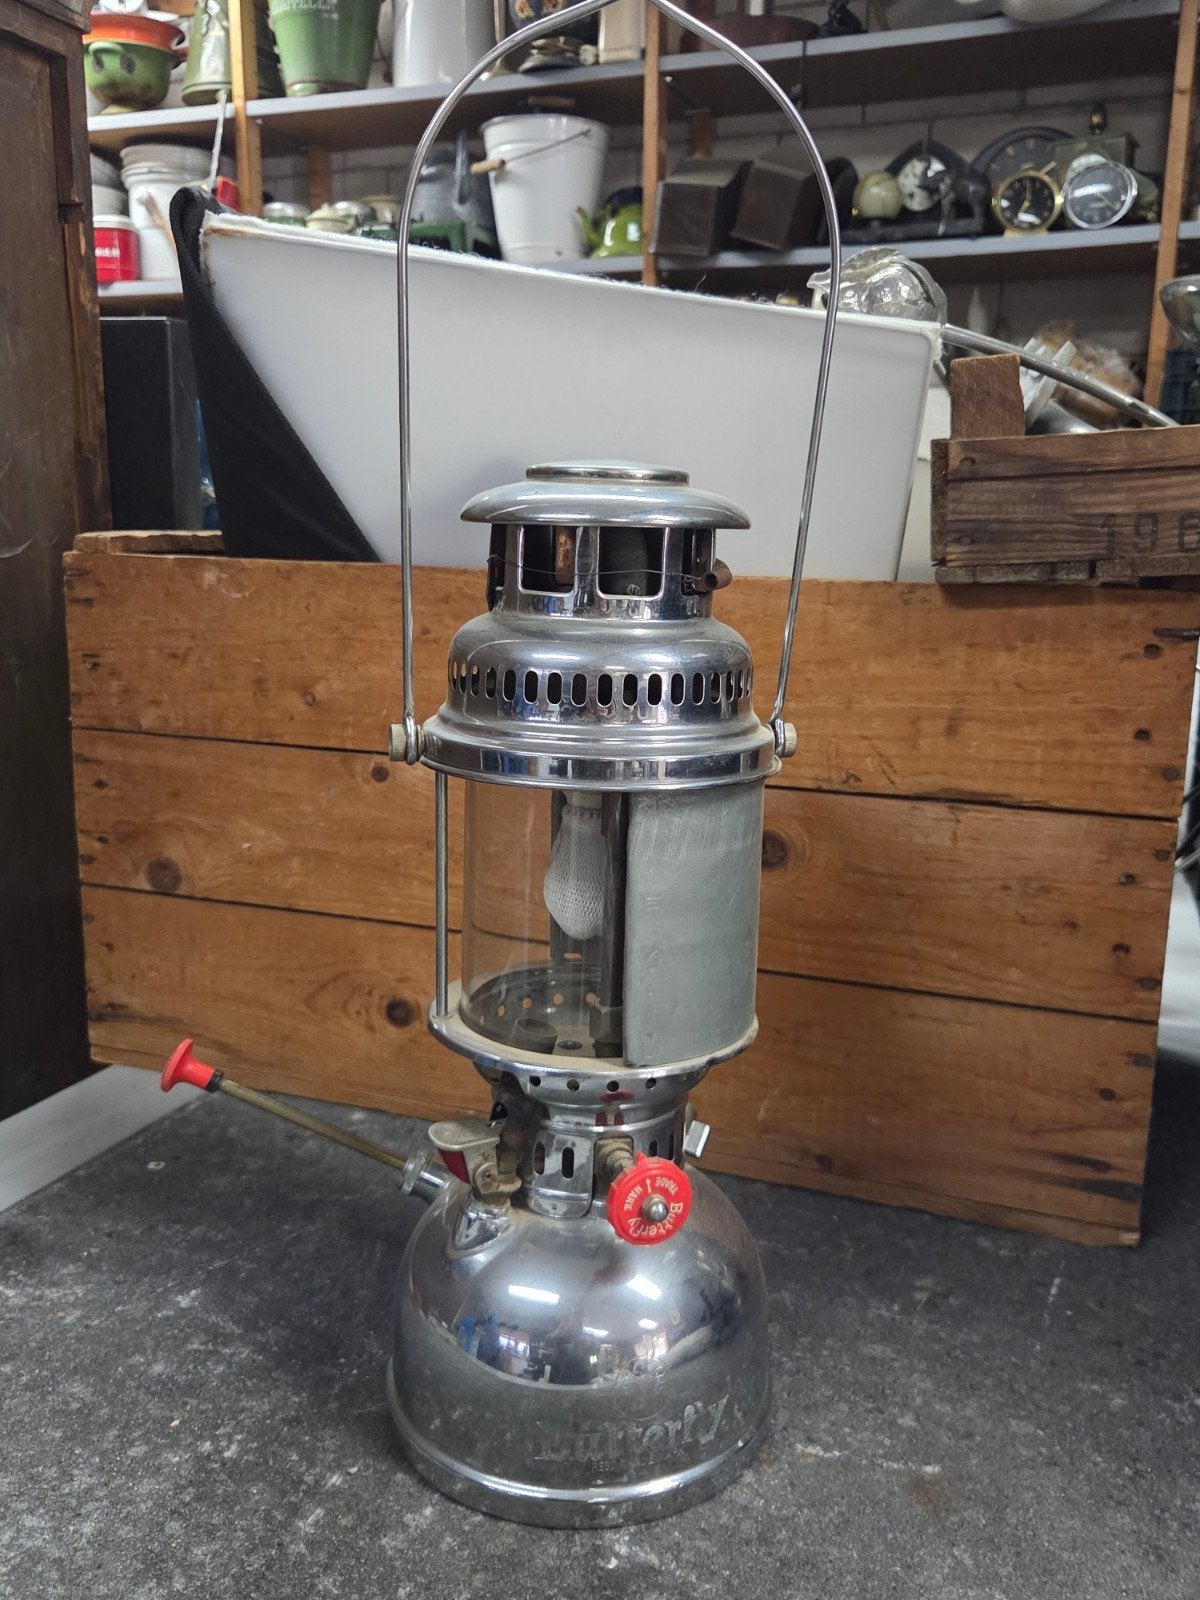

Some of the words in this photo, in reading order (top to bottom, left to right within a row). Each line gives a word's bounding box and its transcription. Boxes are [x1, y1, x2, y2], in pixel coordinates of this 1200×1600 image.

[623, 1184, 643, 1211] MARK
[654, 1176, 679, 1197] TRADE
[628, 1201, 684, 1238] Butterfly
